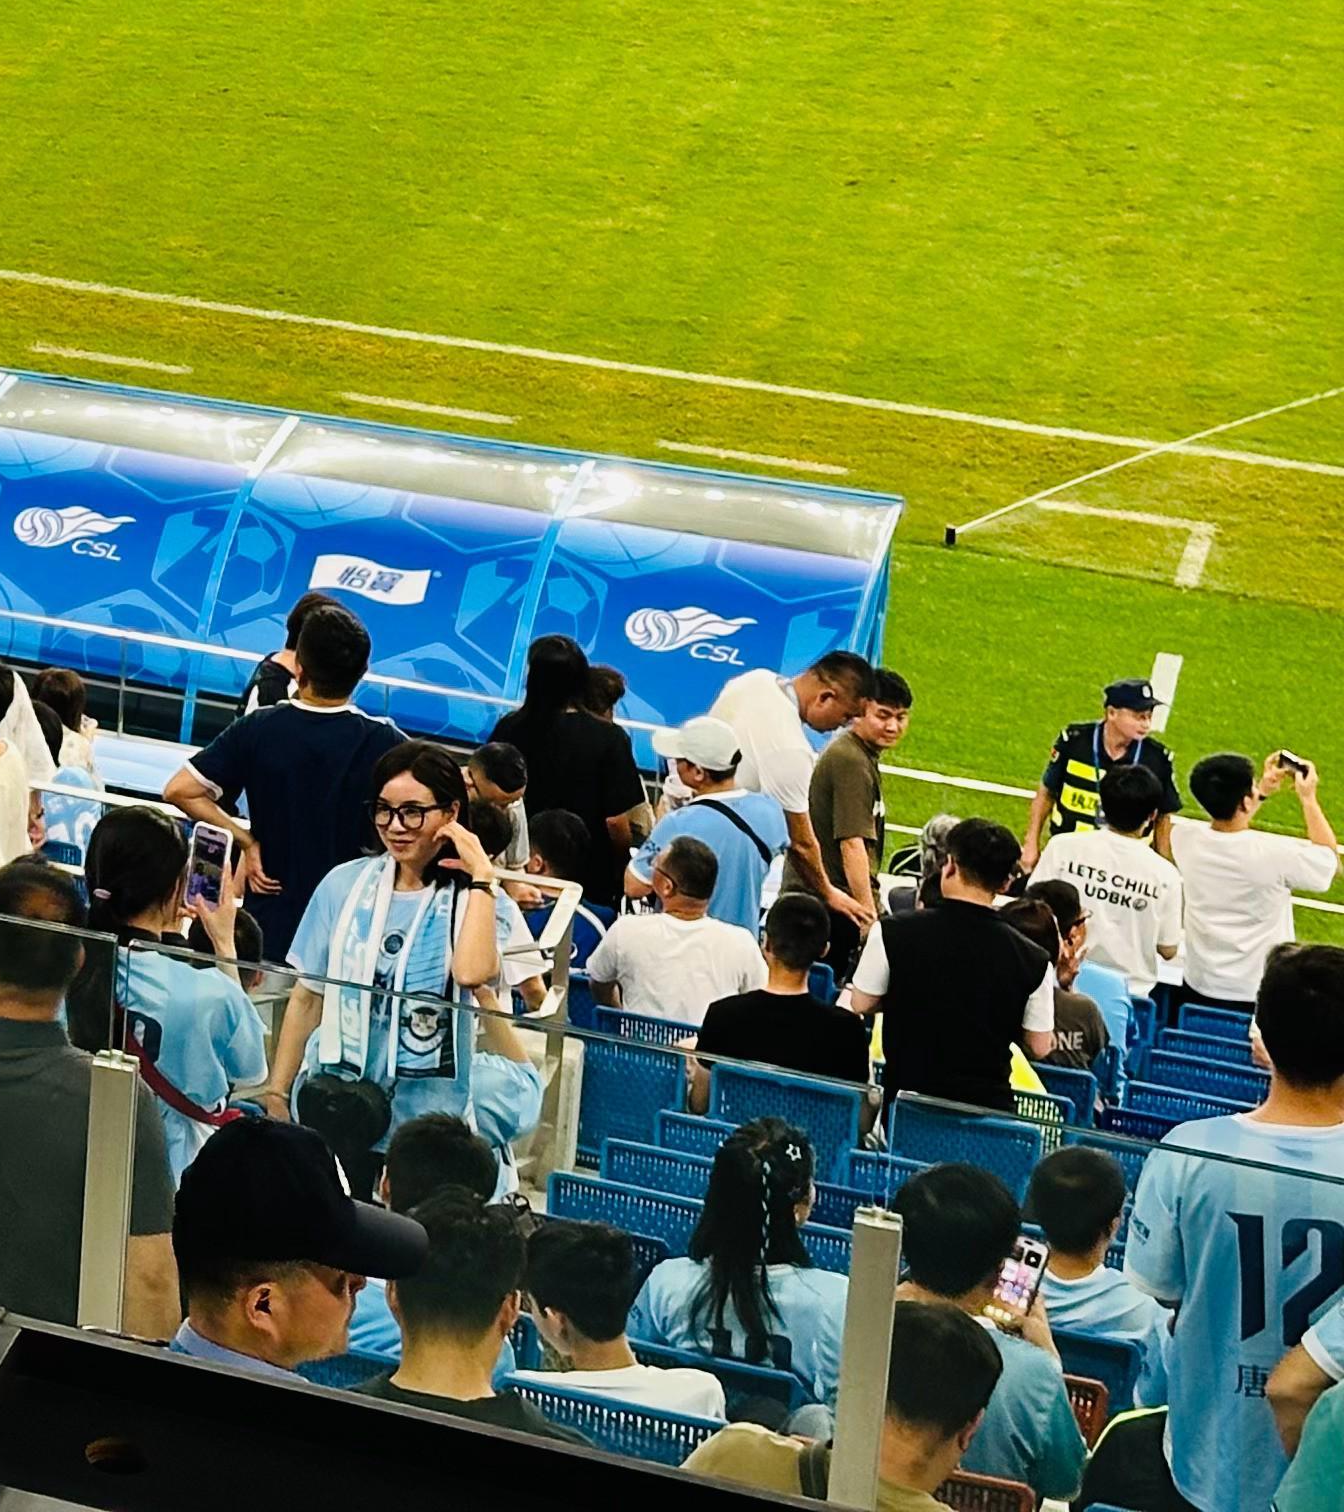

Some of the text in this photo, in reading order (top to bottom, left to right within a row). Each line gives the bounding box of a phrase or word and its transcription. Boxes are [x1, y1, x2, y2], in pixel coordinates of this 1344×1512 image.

[71, 539, 122, 563] CSL
[336, 563, 404, 596] 怡寶
[688, 643, 745, 667] CSL
[1067, 861, 1159, 900] LETS CHILL
[1084, 883, 1132, 908] UDBK
[1224, 1210, 1344, 1348] 12
